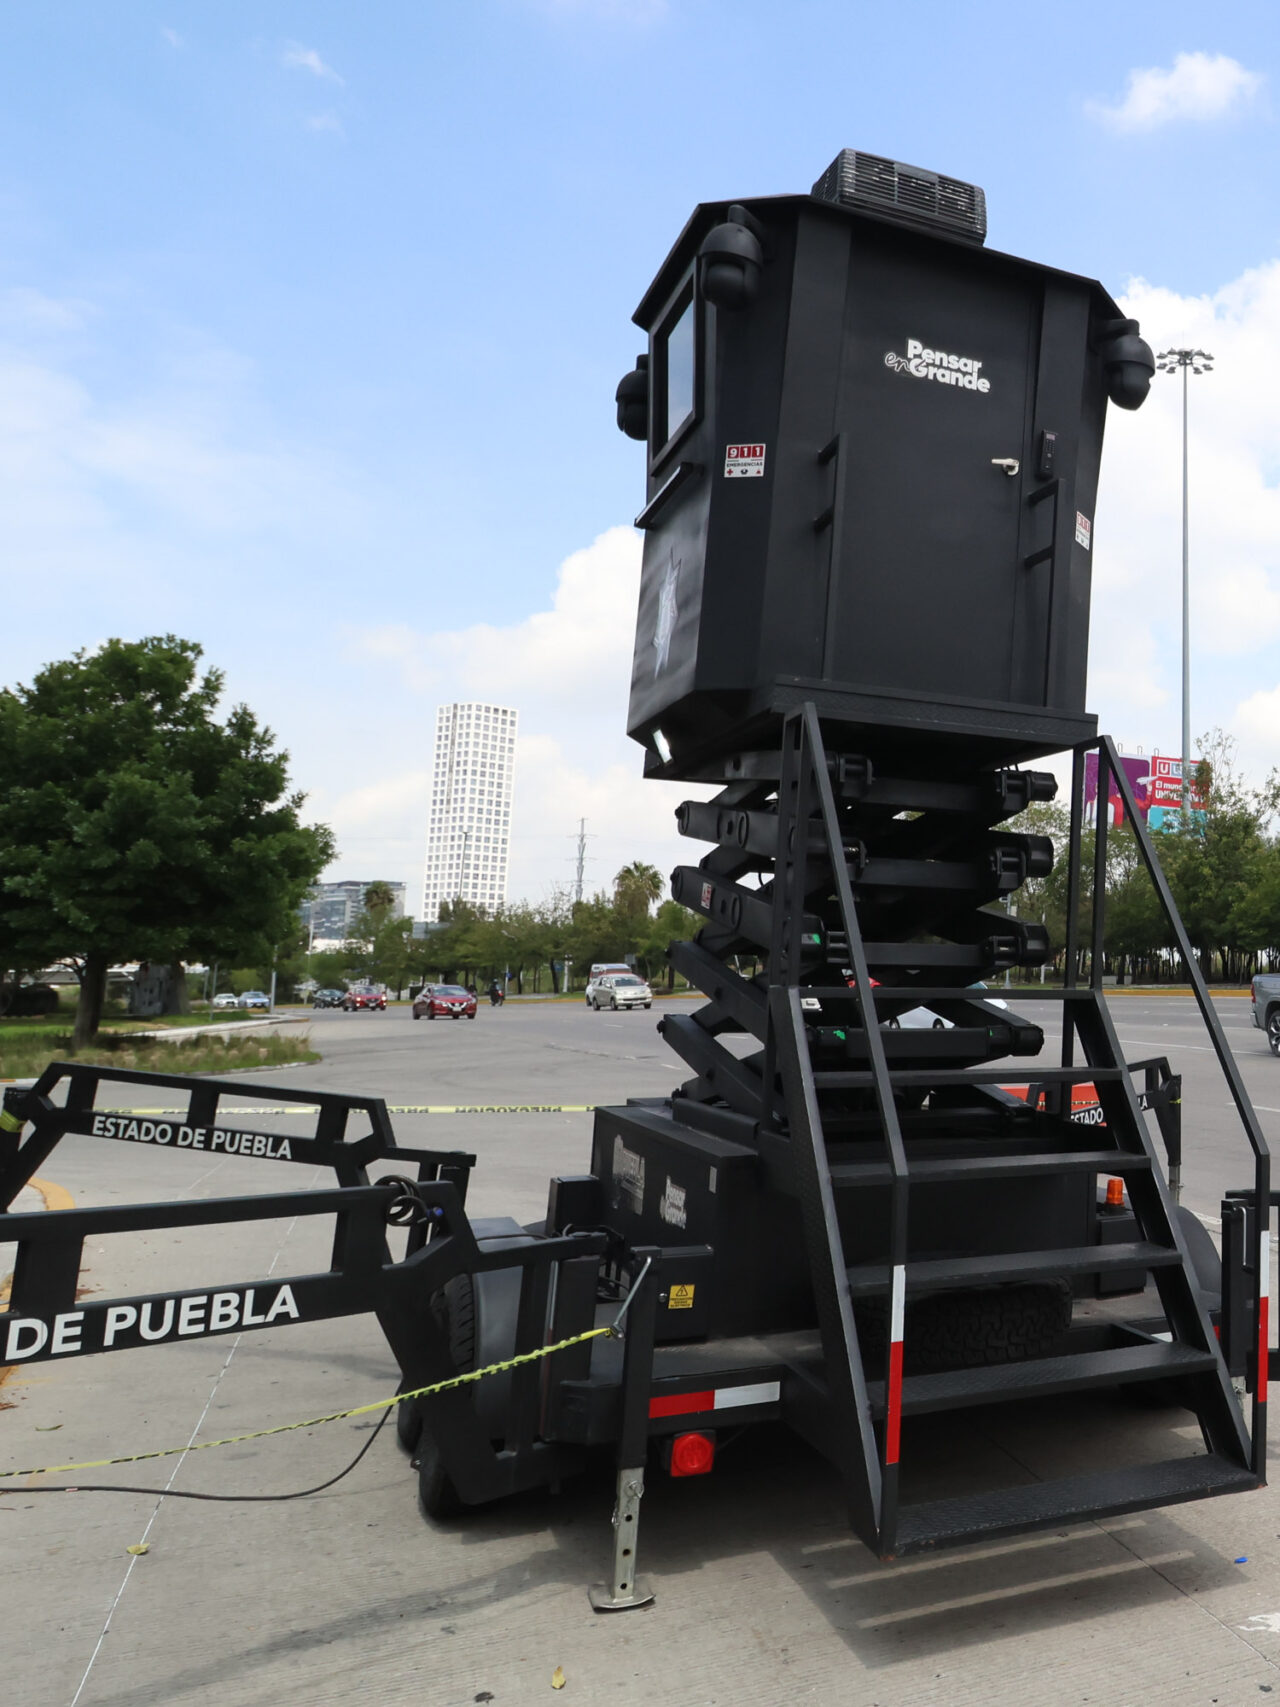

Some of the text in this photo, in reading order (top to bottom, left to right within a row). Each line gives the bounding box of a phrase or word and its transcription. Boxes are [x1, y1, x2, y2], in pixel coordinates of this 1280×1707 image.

[885, 352, 991, 393] en Grande
[907, 338, 982, 373] Pensar
[729, 446, 762, 458] 911
[1155, 780, 1162, 789] El
[92, 1115, 293, 1160] ESTADO DE PUEBLA
[5, 1284, 300, 1361] DE PUEBLA
